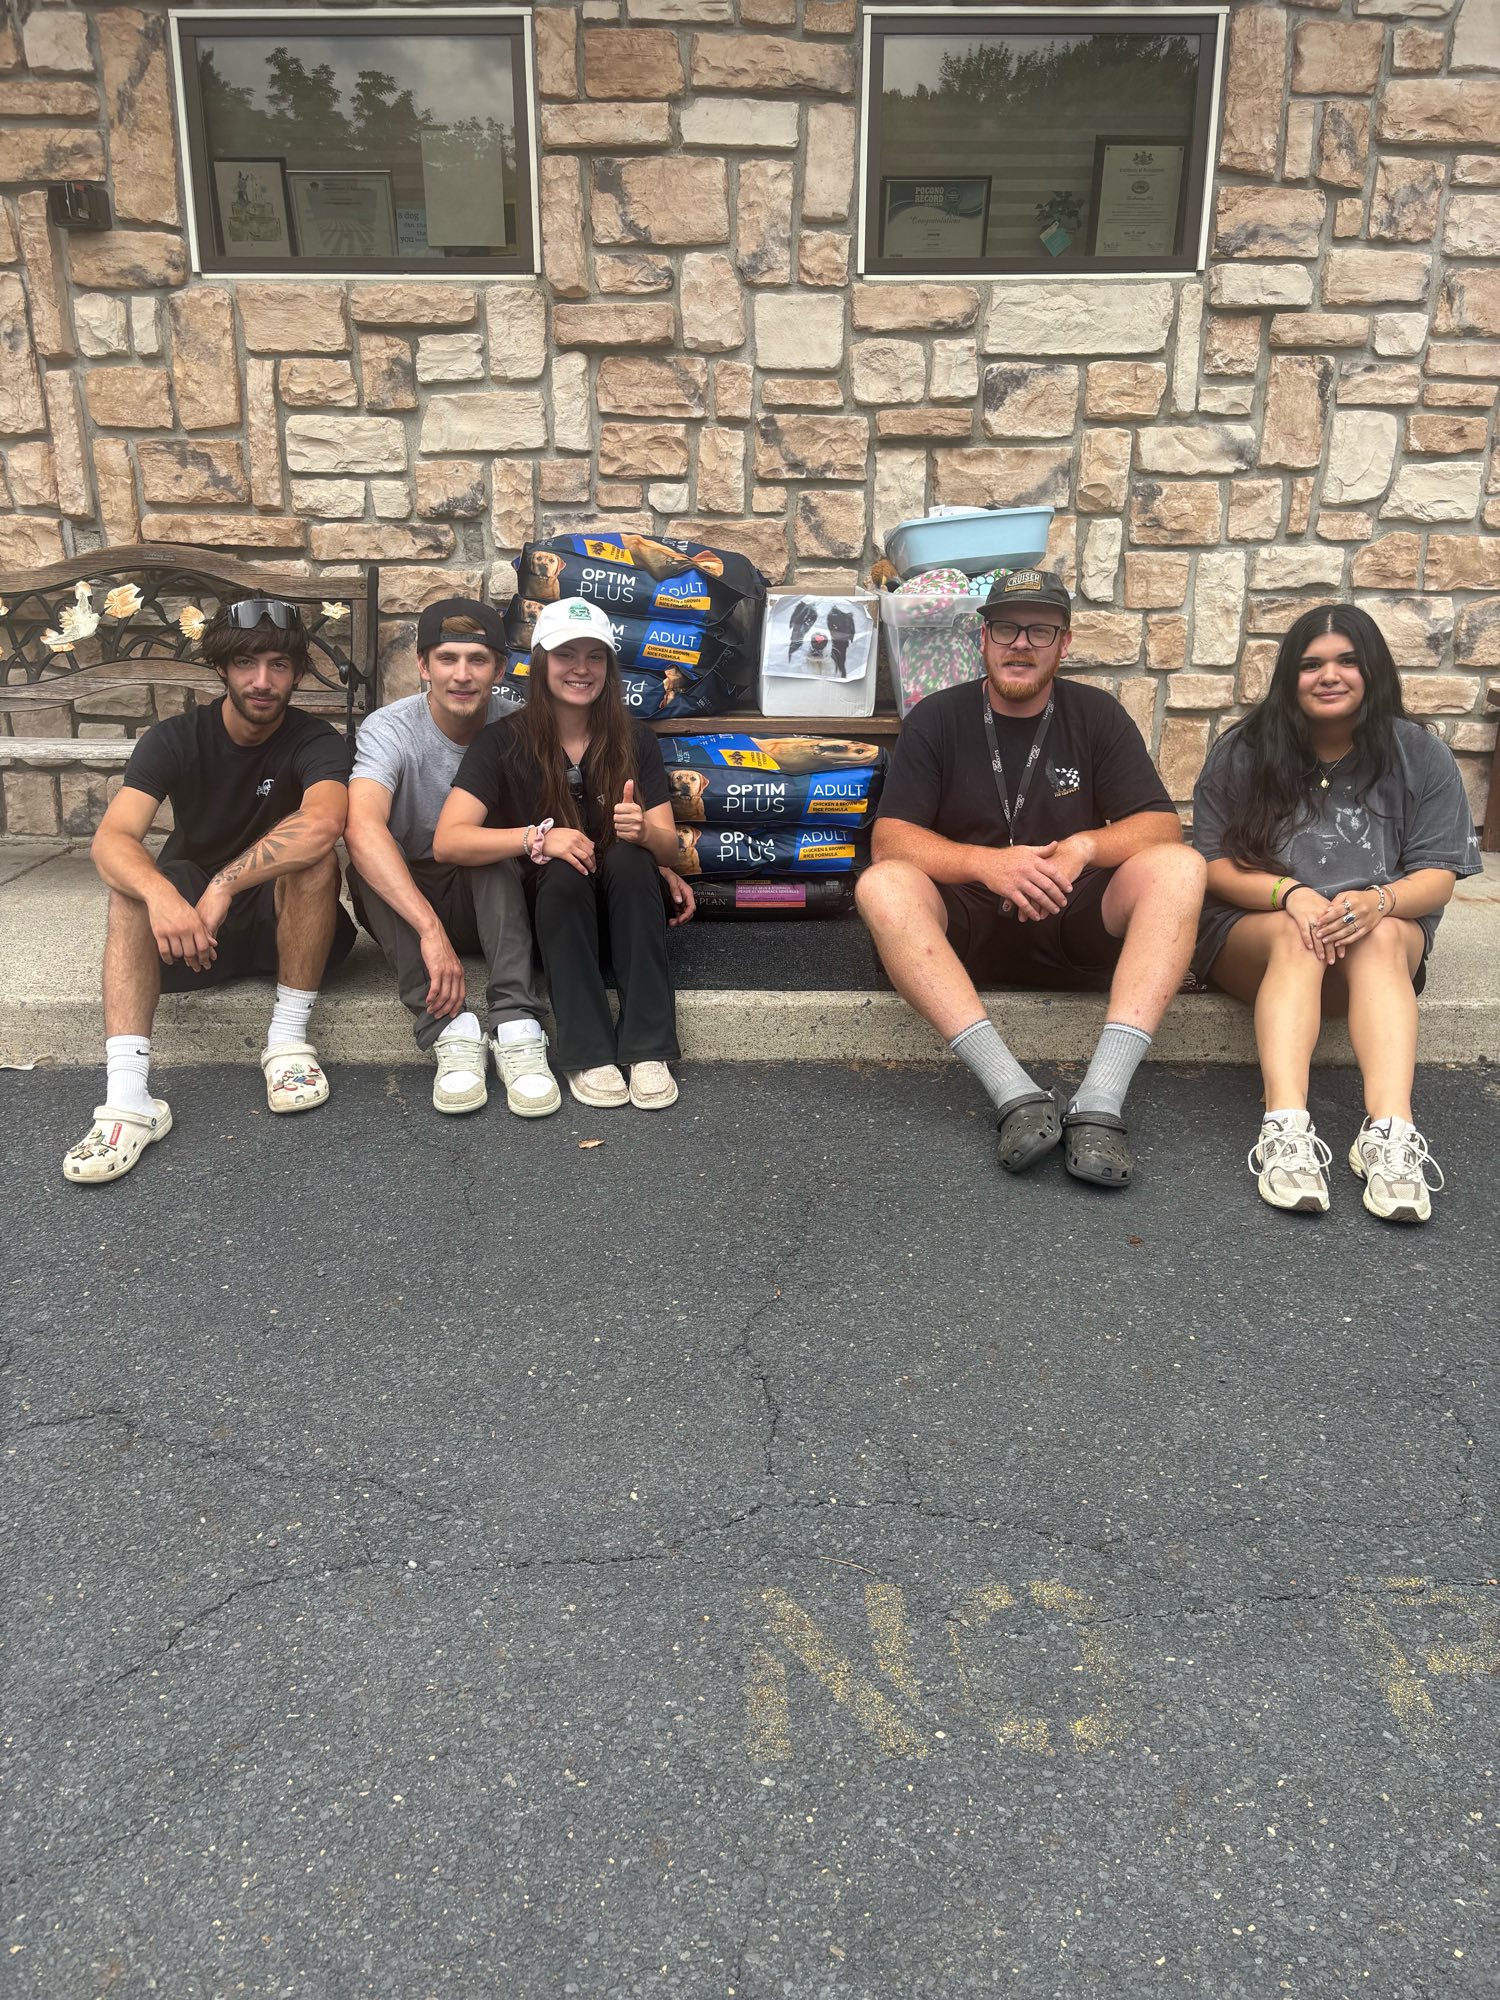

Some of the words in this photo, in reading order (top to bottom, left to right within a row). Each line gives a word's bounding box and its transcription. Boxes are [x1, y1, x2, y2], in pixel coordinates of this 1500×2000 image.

[915, 186, 944, 195] POCONO
[914, 195, 944, 203] RECORD
[582, 568, 637, 587] OPTIM
[1007, 573, 1040, 586] CRUISER
[576, 581, 634, 602] PLUS
[648, 630, 697, 647] ADULT
[647, 645, 669, 654] CHICKEN
[658, 652, 681, 660] FORMULA
[727, 783, 785, 796] OPTIM
[813, 784, 863, 796] ADULT
[722, 797, 785, 813] PLUS
[801, 830, 848, 844] ADULT
[716, 845, 776, 862] PLUS
[700, 897, 726, 906] PLAN
